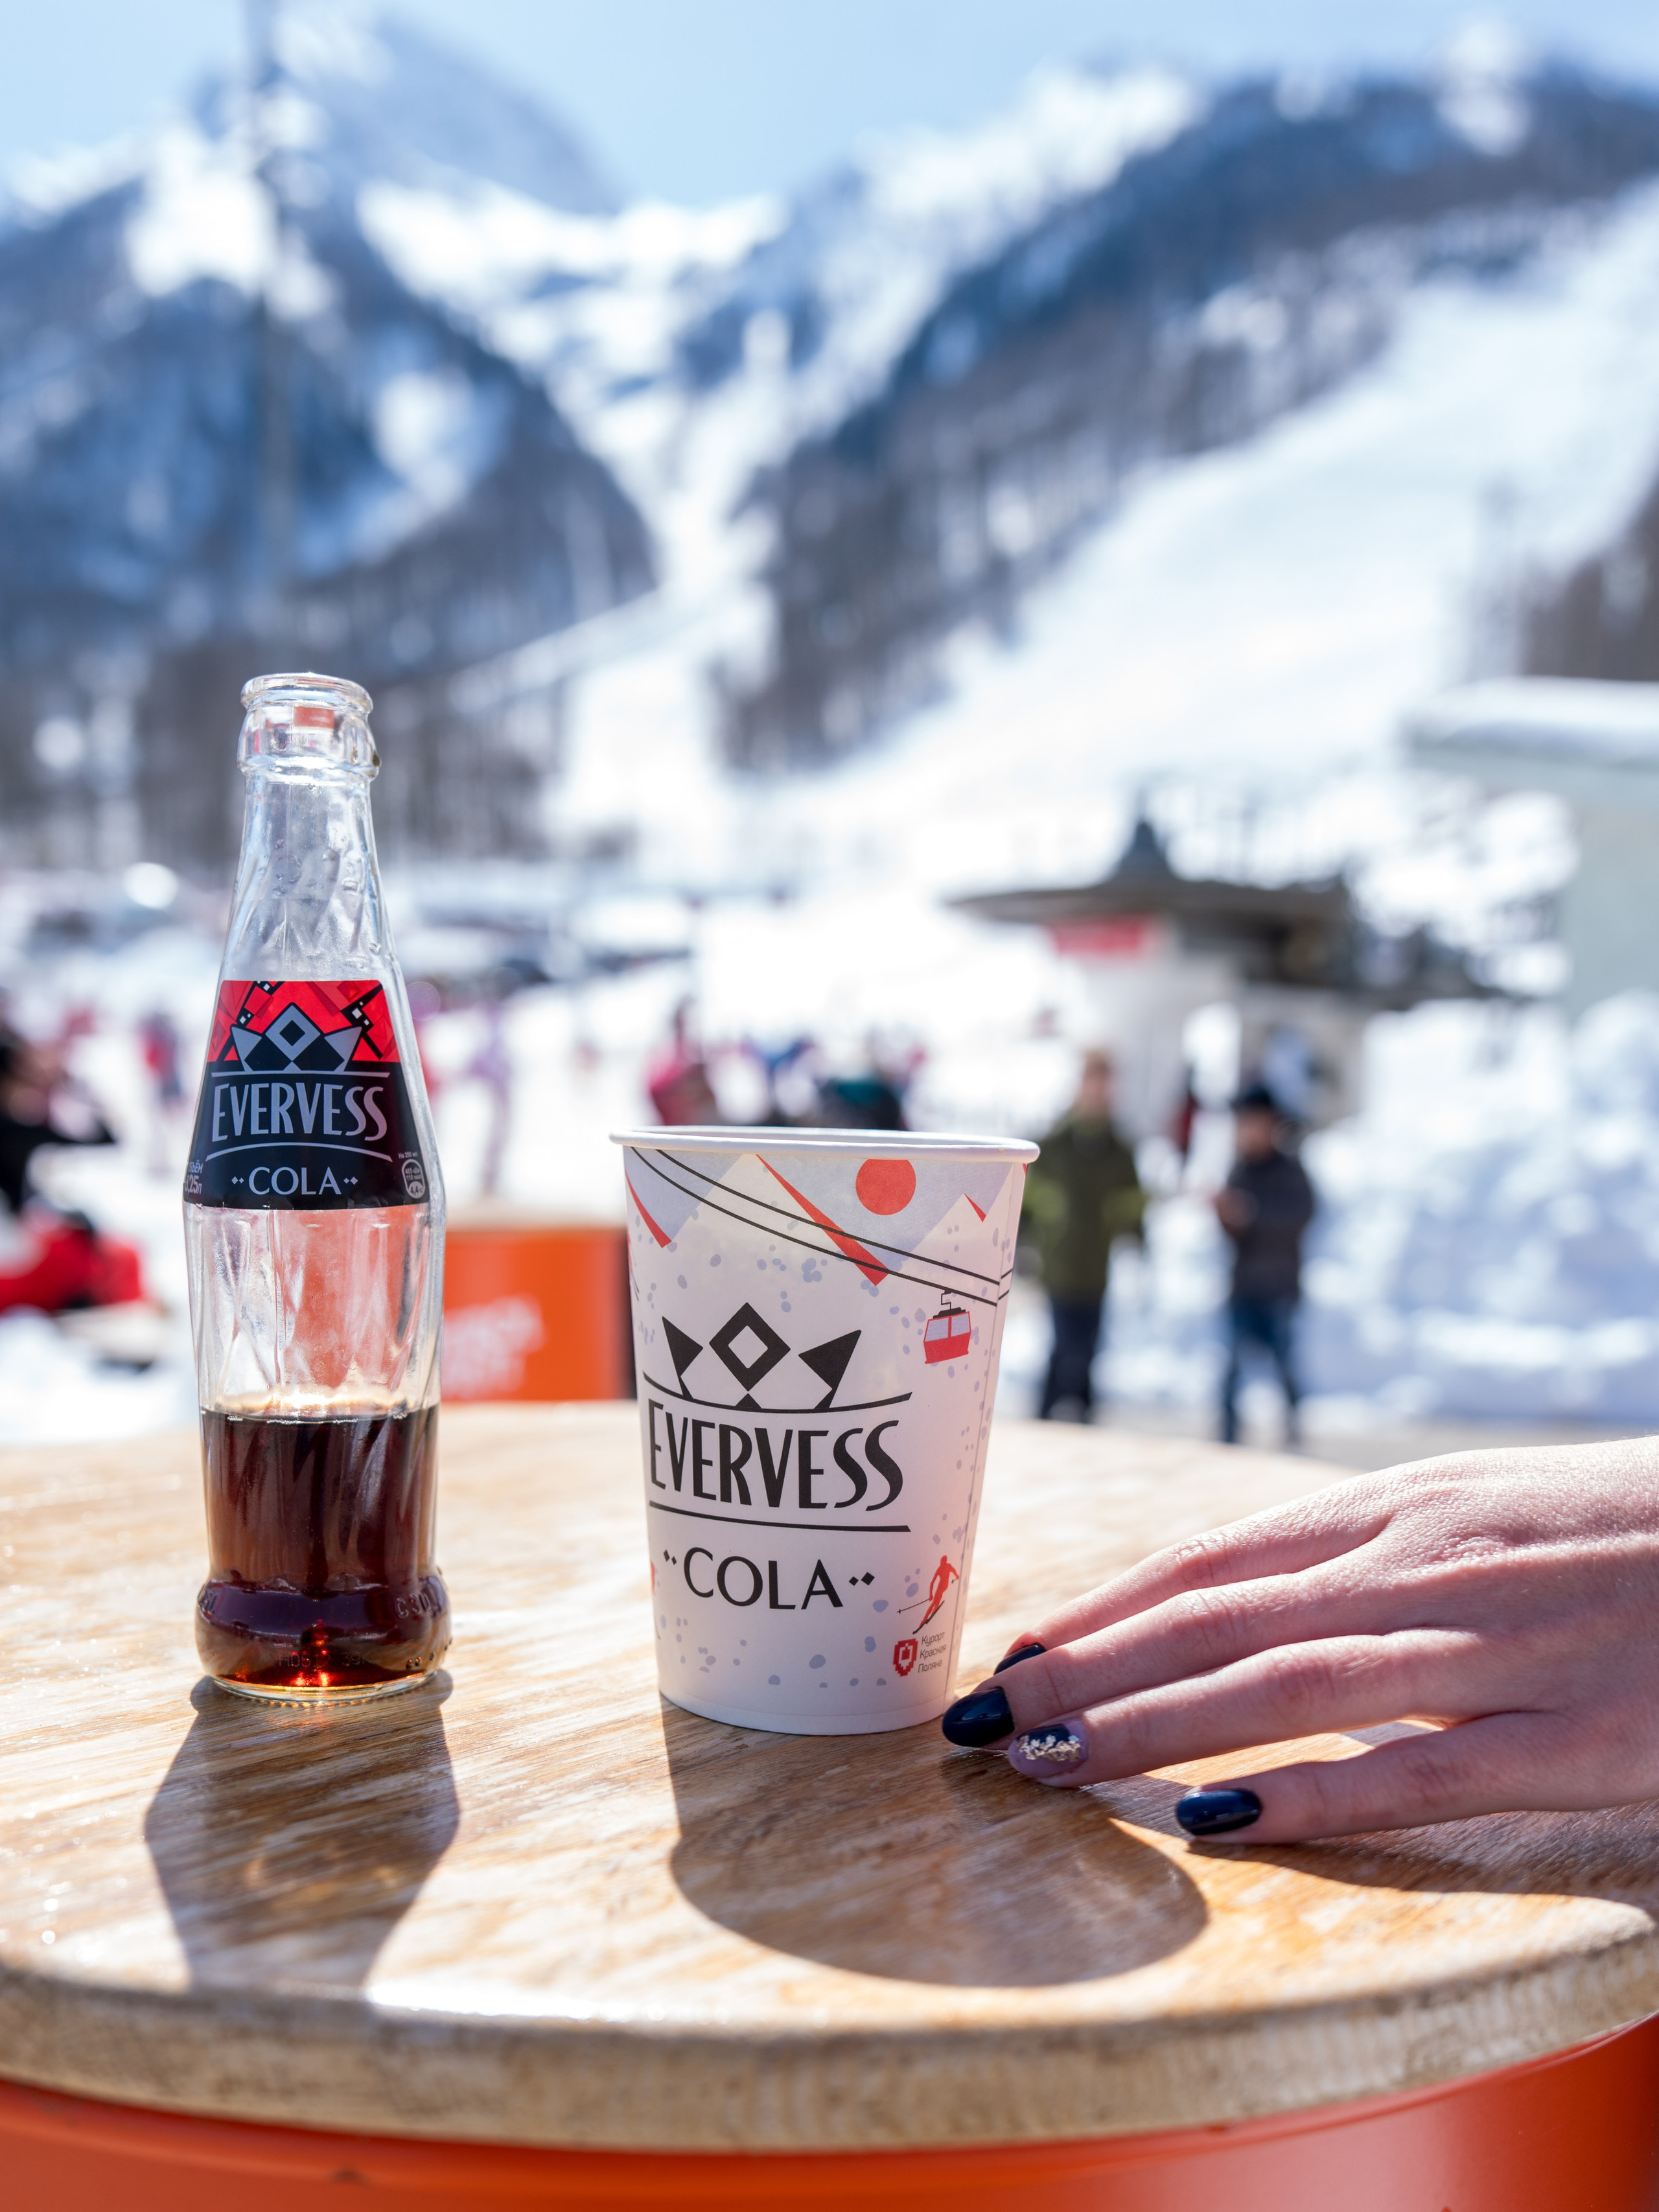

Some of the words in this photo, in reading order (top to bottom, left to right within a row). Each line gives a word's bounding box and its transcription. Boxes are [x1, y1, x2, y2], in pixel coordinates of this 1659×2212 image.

[213, 1083, 388, 1142] EVERVESS
[249, 1167, 342, 1195] COLA
[649, 1398, 903, 1511] EVERVESS
[683, 1546, 844, 1610] COLA
[920, 1644, 946, 1659] Красная
[922, 1632, 945, 1646] Курорт
[918, 1659, 942, 1673] Поляна
